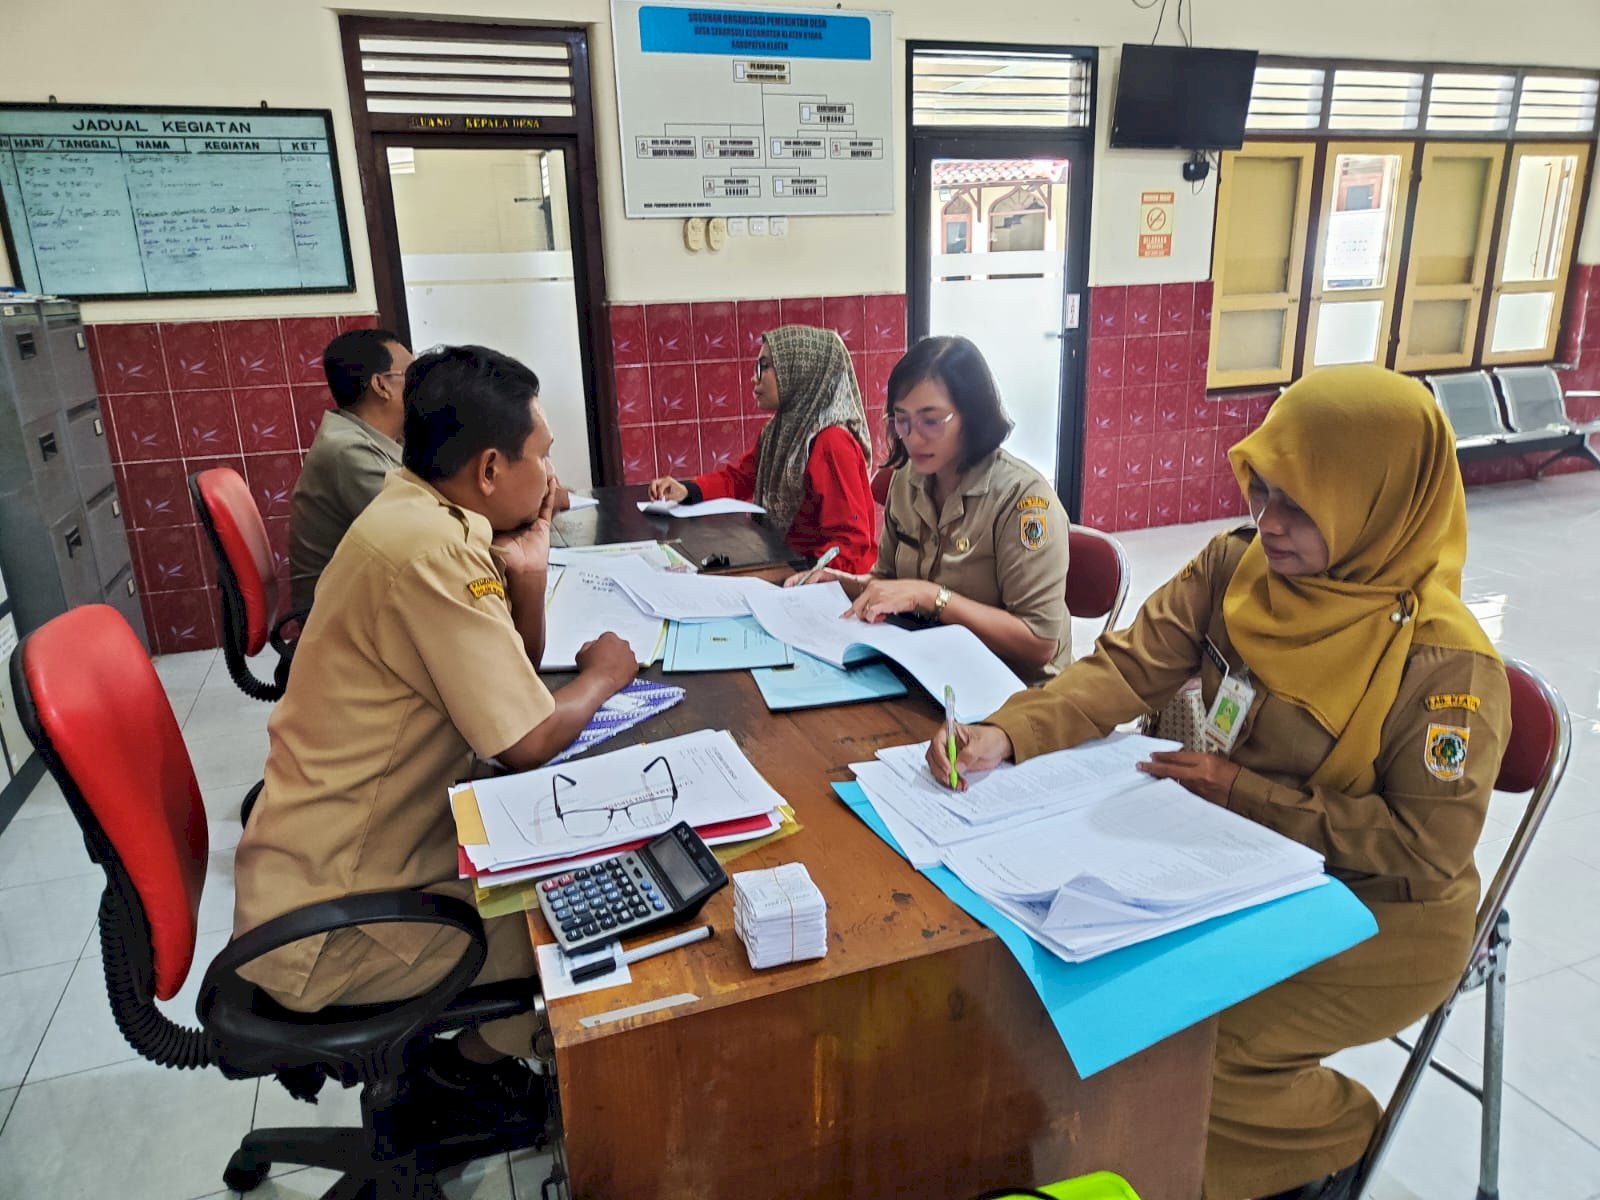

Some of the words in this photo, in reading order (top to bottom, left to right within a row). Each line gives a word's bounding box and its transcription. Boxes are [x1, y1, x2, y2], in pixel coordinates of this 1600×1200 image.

[73, 118, 148, 133] JADUAL
[162, 120, 252, 134] KEGIATAN
[14, 139, 44, 148] HARI
[57, 140, 117, 149] TANGGAL
[135, 140, 171, 150] NAMA
[204, 141, 260, 151] KEGIATAN
[291, 142, 318, 151] KET
